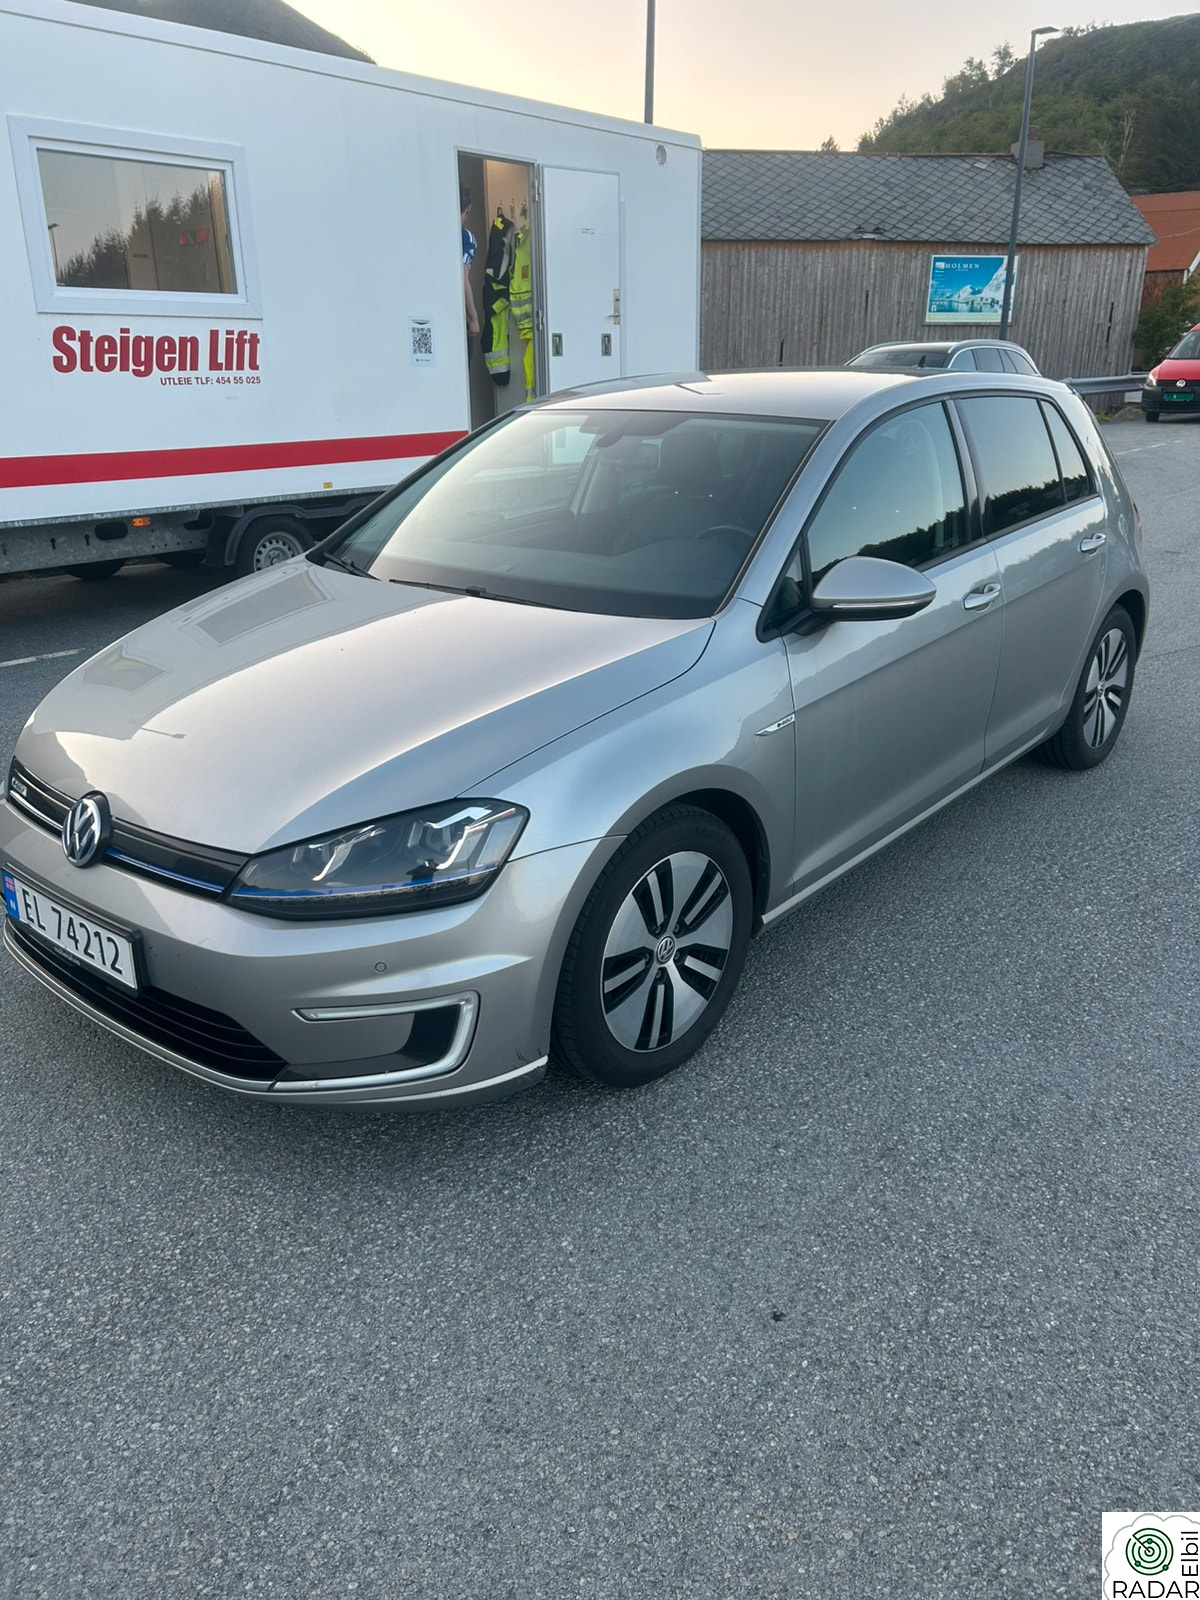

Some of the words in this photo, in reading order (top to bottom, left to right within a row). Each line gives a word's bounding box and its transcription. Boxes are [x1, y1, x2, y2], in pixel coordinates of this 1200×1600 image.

[52, 325, 199, 378] Steigen
[208, 329, 260, 371] Lift
[160, 376, 192, 386] UTLEIE
[194, 376, 214, 385] TLF:
[215, 376, 231, 385] 454
[233, 376, 244, 384] 55
[246, 376, 261, 384] 025
[22, 887, 46, 931] EL
[51, 905, 123, 975] 74212
